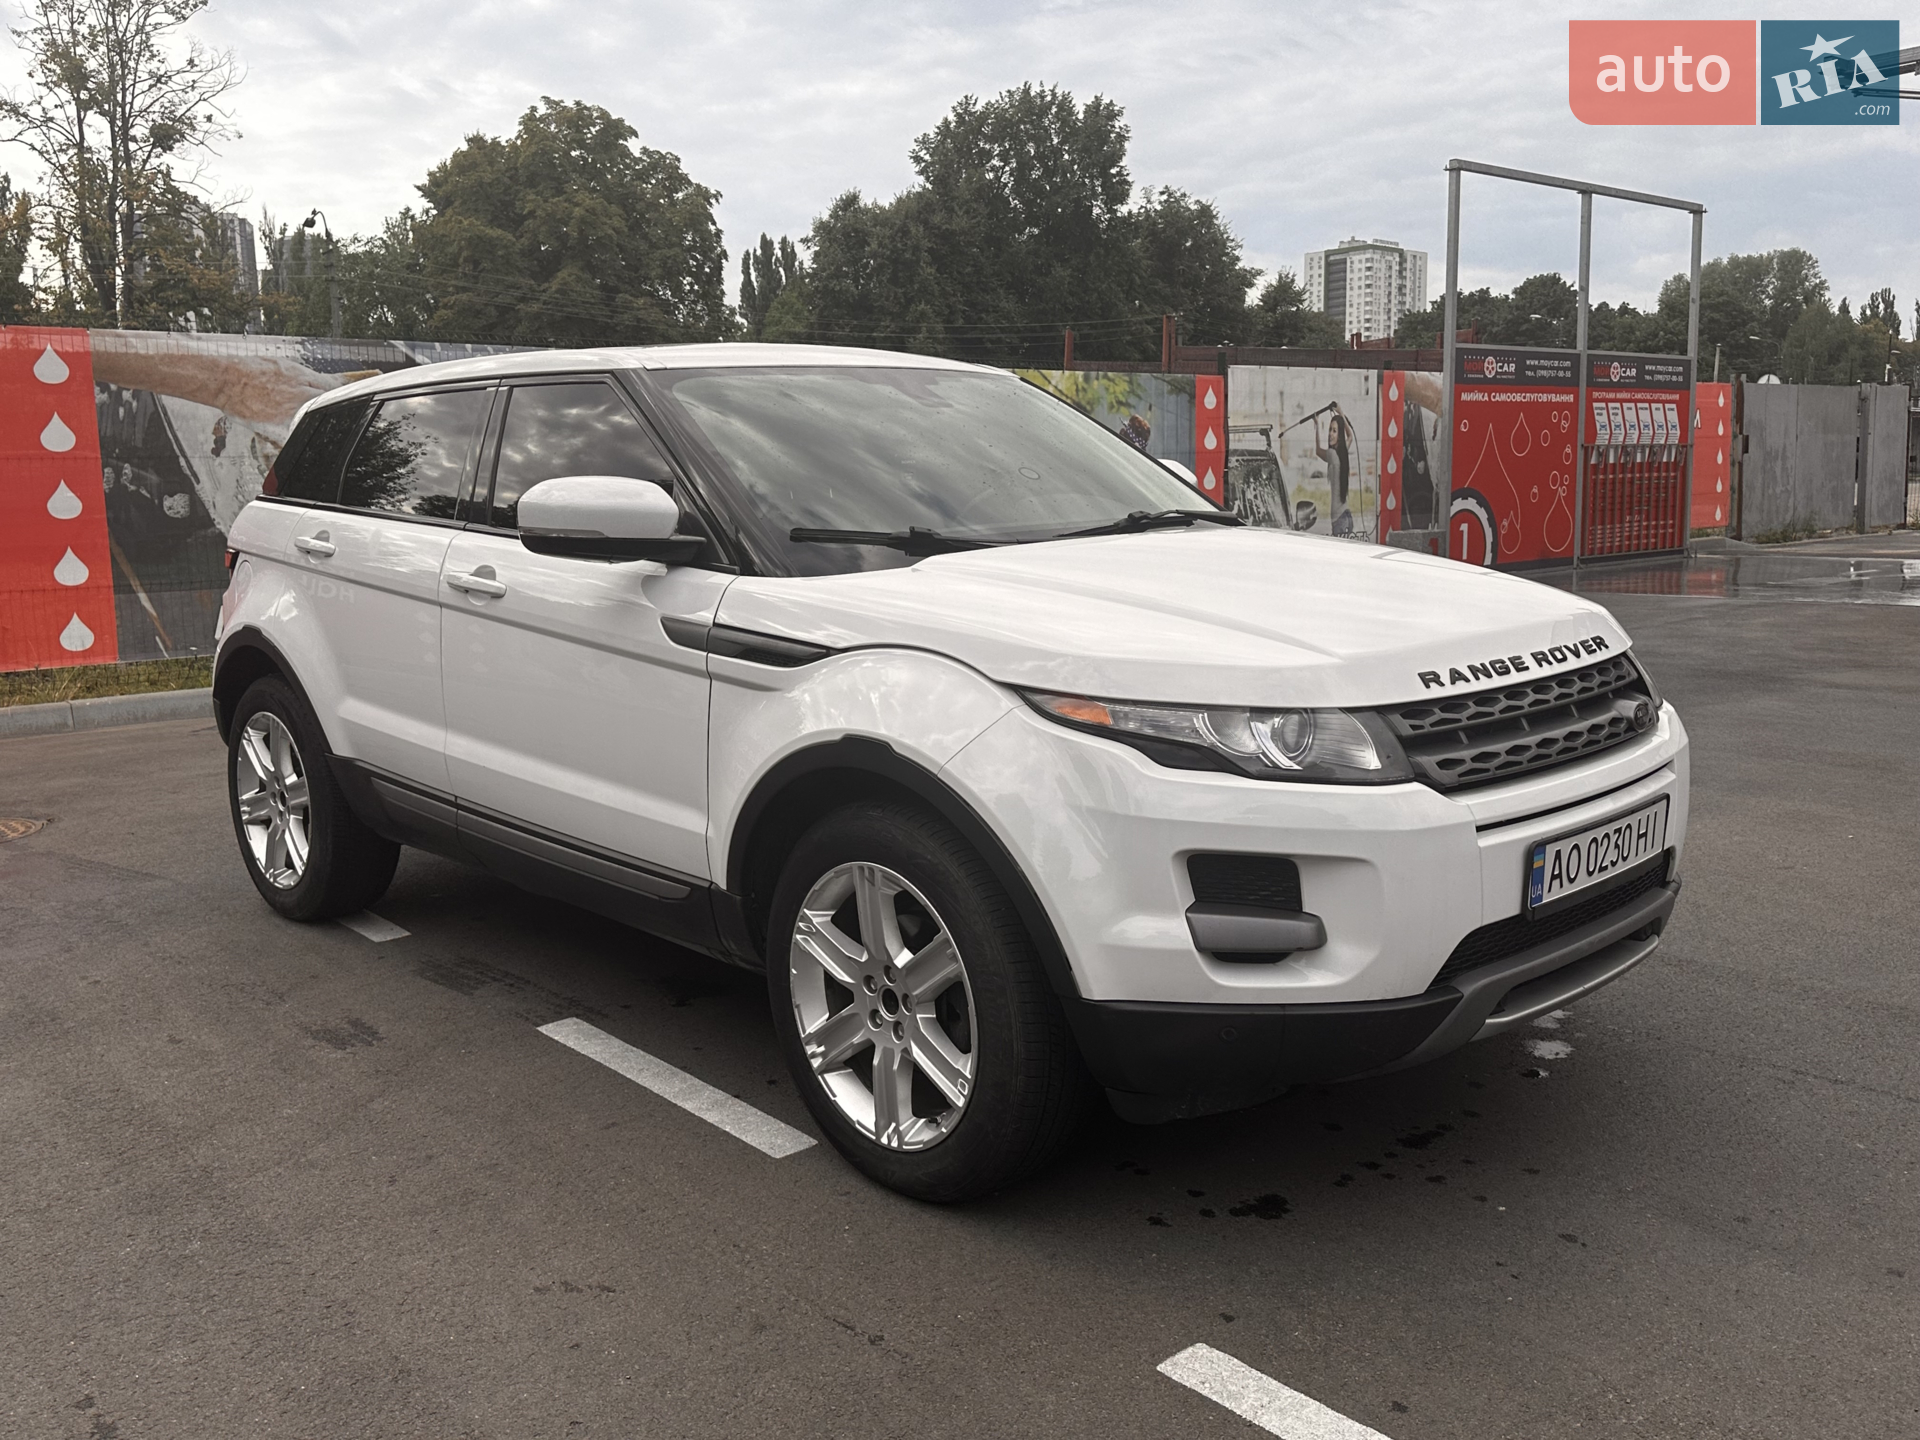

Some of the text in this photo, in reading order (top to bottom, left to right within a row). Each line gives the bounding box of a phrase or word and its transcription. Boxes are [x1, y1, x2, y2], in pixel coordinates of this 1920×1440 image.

[1497, 363, 1516, 373] CAR
[1526, 359, 1572, 368] www.moycar.com
[1620, 368, 1637, 377] CAR
[1460, 390, 1574, 403] МИЙКА САМООБСЛУГОВУВАННЯ
[1459, 523, 1468, 560] 1
[1418, 635, 1610, 689] RANGE ROVER
[1548, 811, 1658, 893] AO 0230 HI
[1531, 885, 1543, 898] UA
